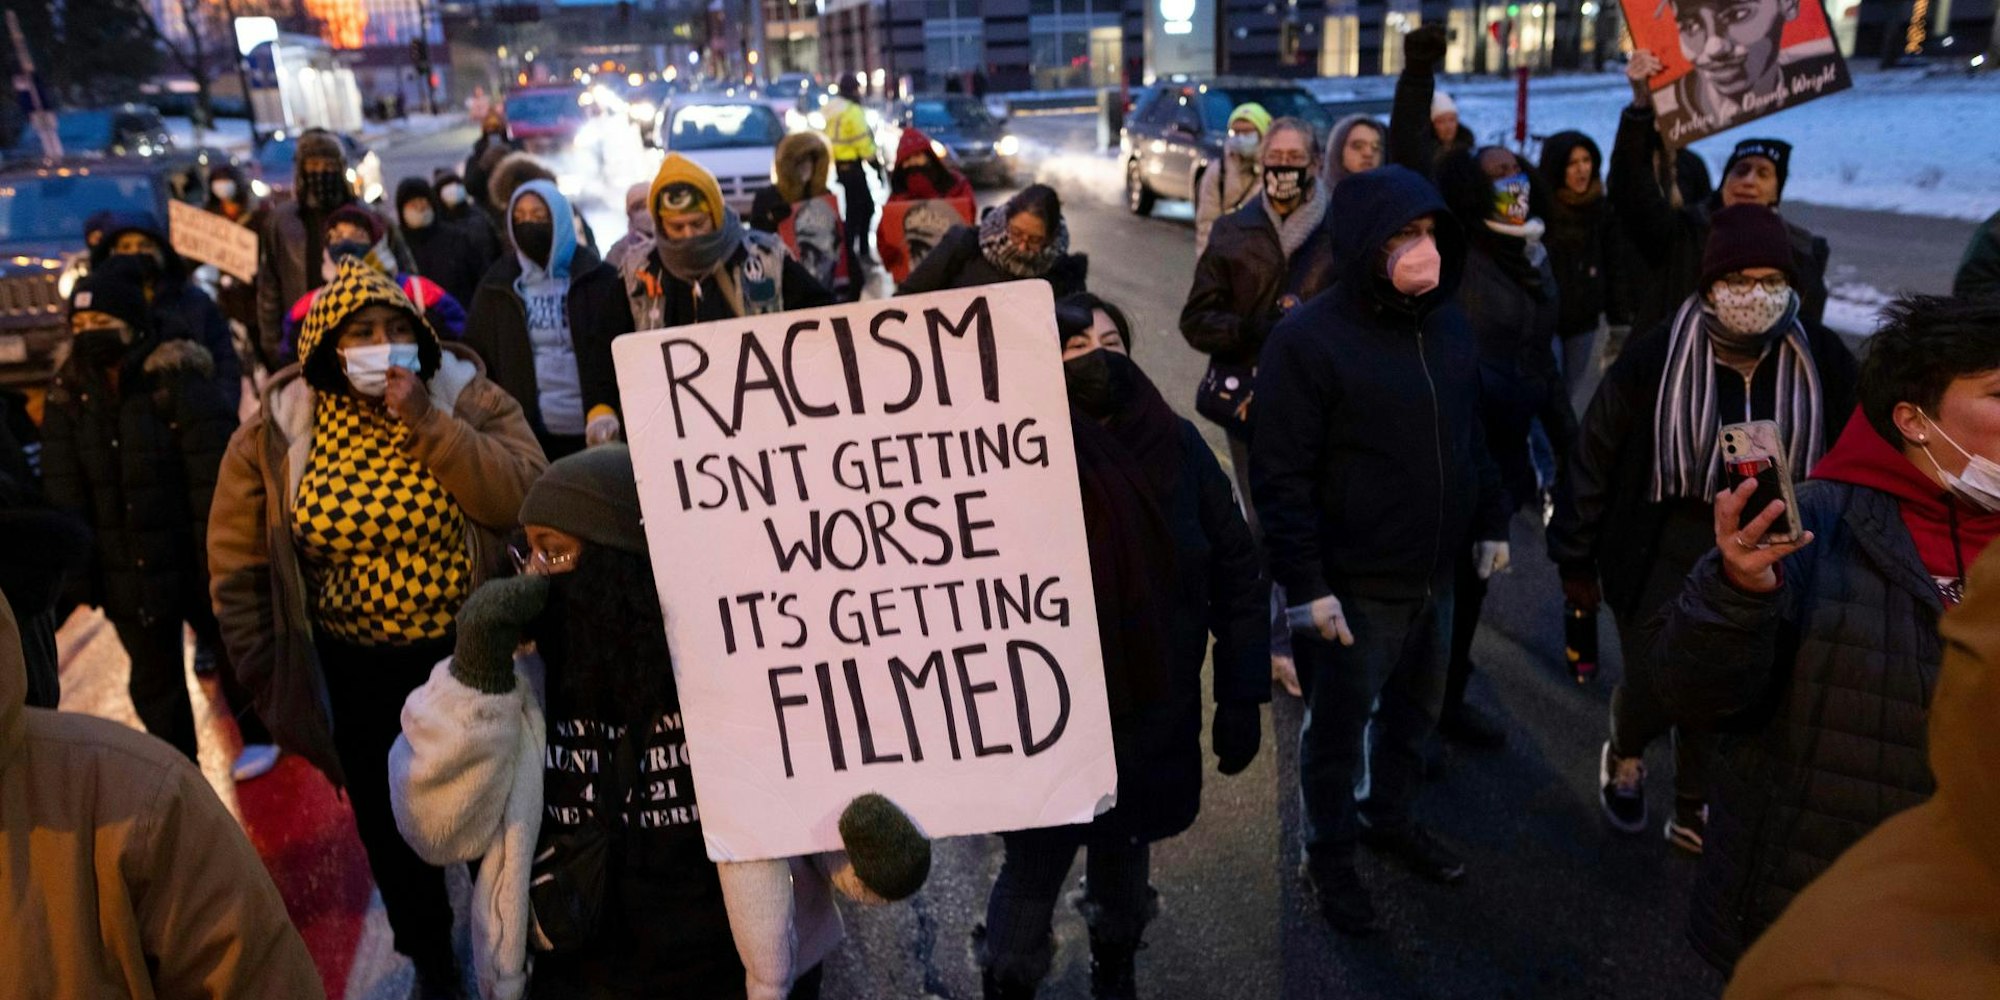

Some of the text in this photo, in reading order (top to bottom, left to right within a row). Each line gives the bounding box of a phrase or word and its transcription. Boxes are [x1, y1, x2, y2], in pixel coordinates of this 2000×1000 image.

[1792, 63, 1836, 94] Wright
[661, 296, 1000, 438] RACISM
[674, 418, 1050, 511] ISN'T GETTING
[764, 490, 999, 572] WORSE
[719, 574, 1070, 654] IT'S GETTING
[768, 640, 1070, 778] FILMED
